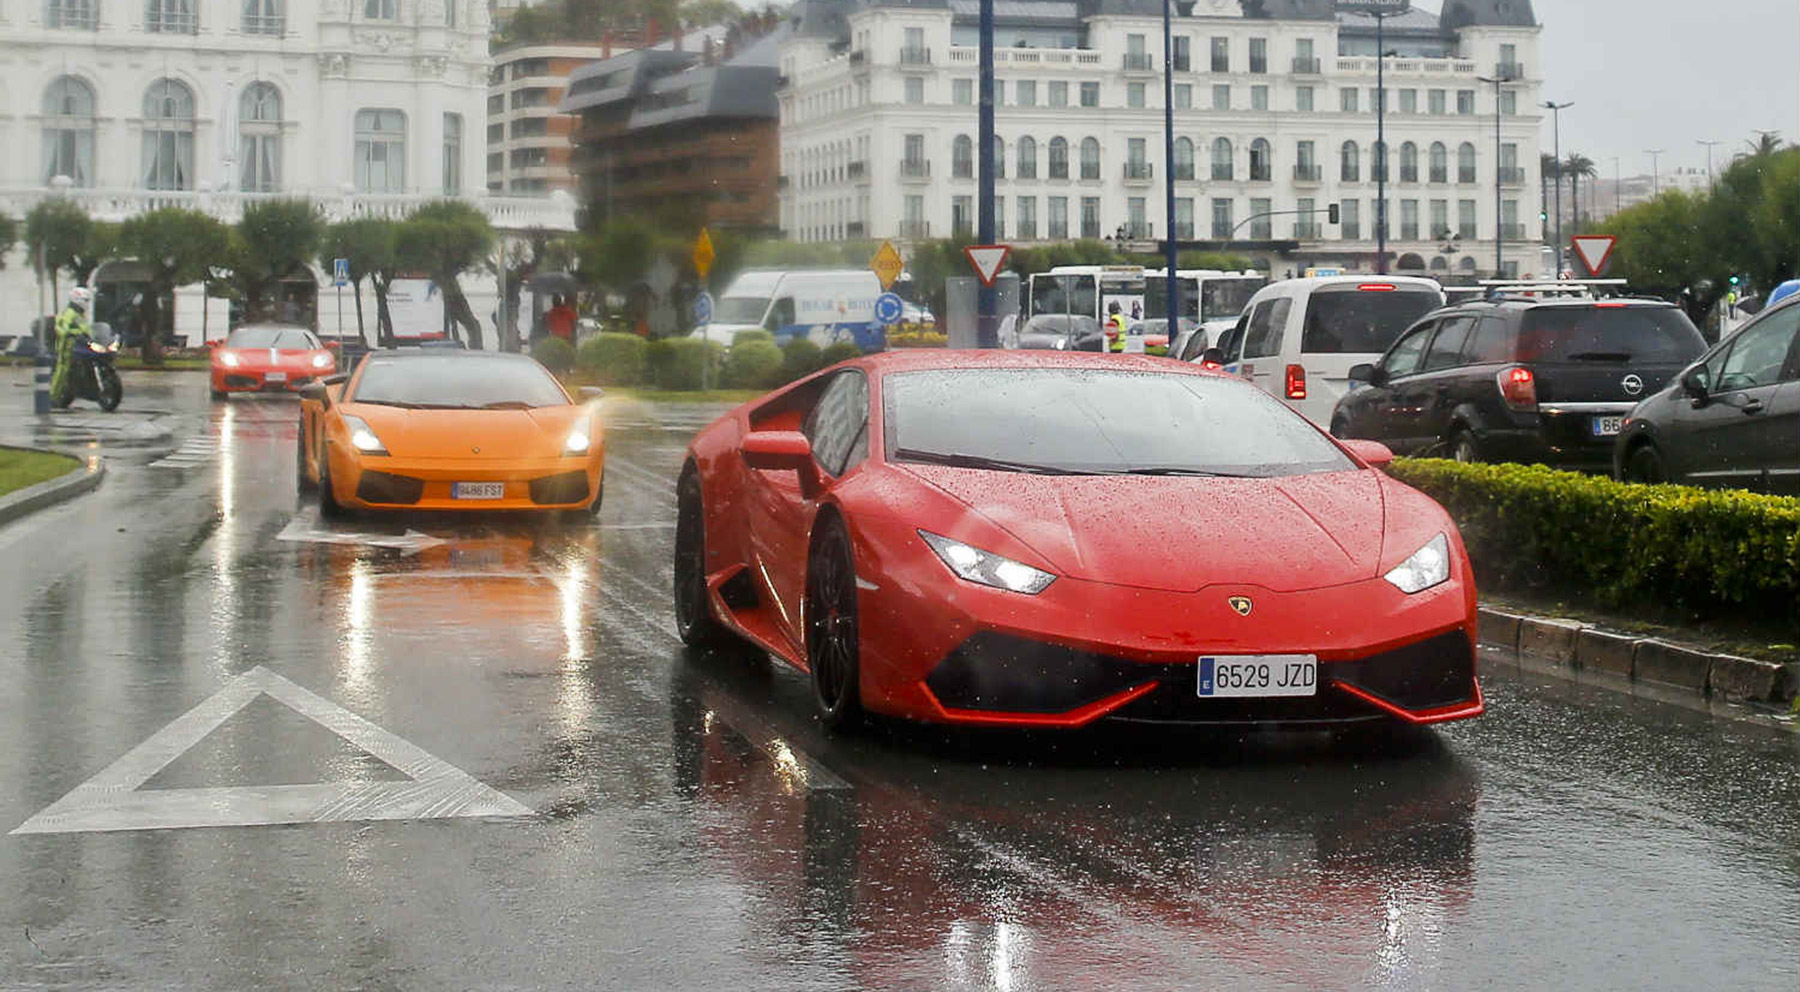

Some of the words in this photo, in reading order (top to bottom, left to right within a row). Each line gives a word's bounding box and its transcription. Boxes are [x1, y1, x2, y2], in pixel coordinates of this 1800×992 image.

[1216, 664, 1270, 688] 6529
[1277, 663, 1315, 687] JZD
[1202, 680, 1210, 690] E
